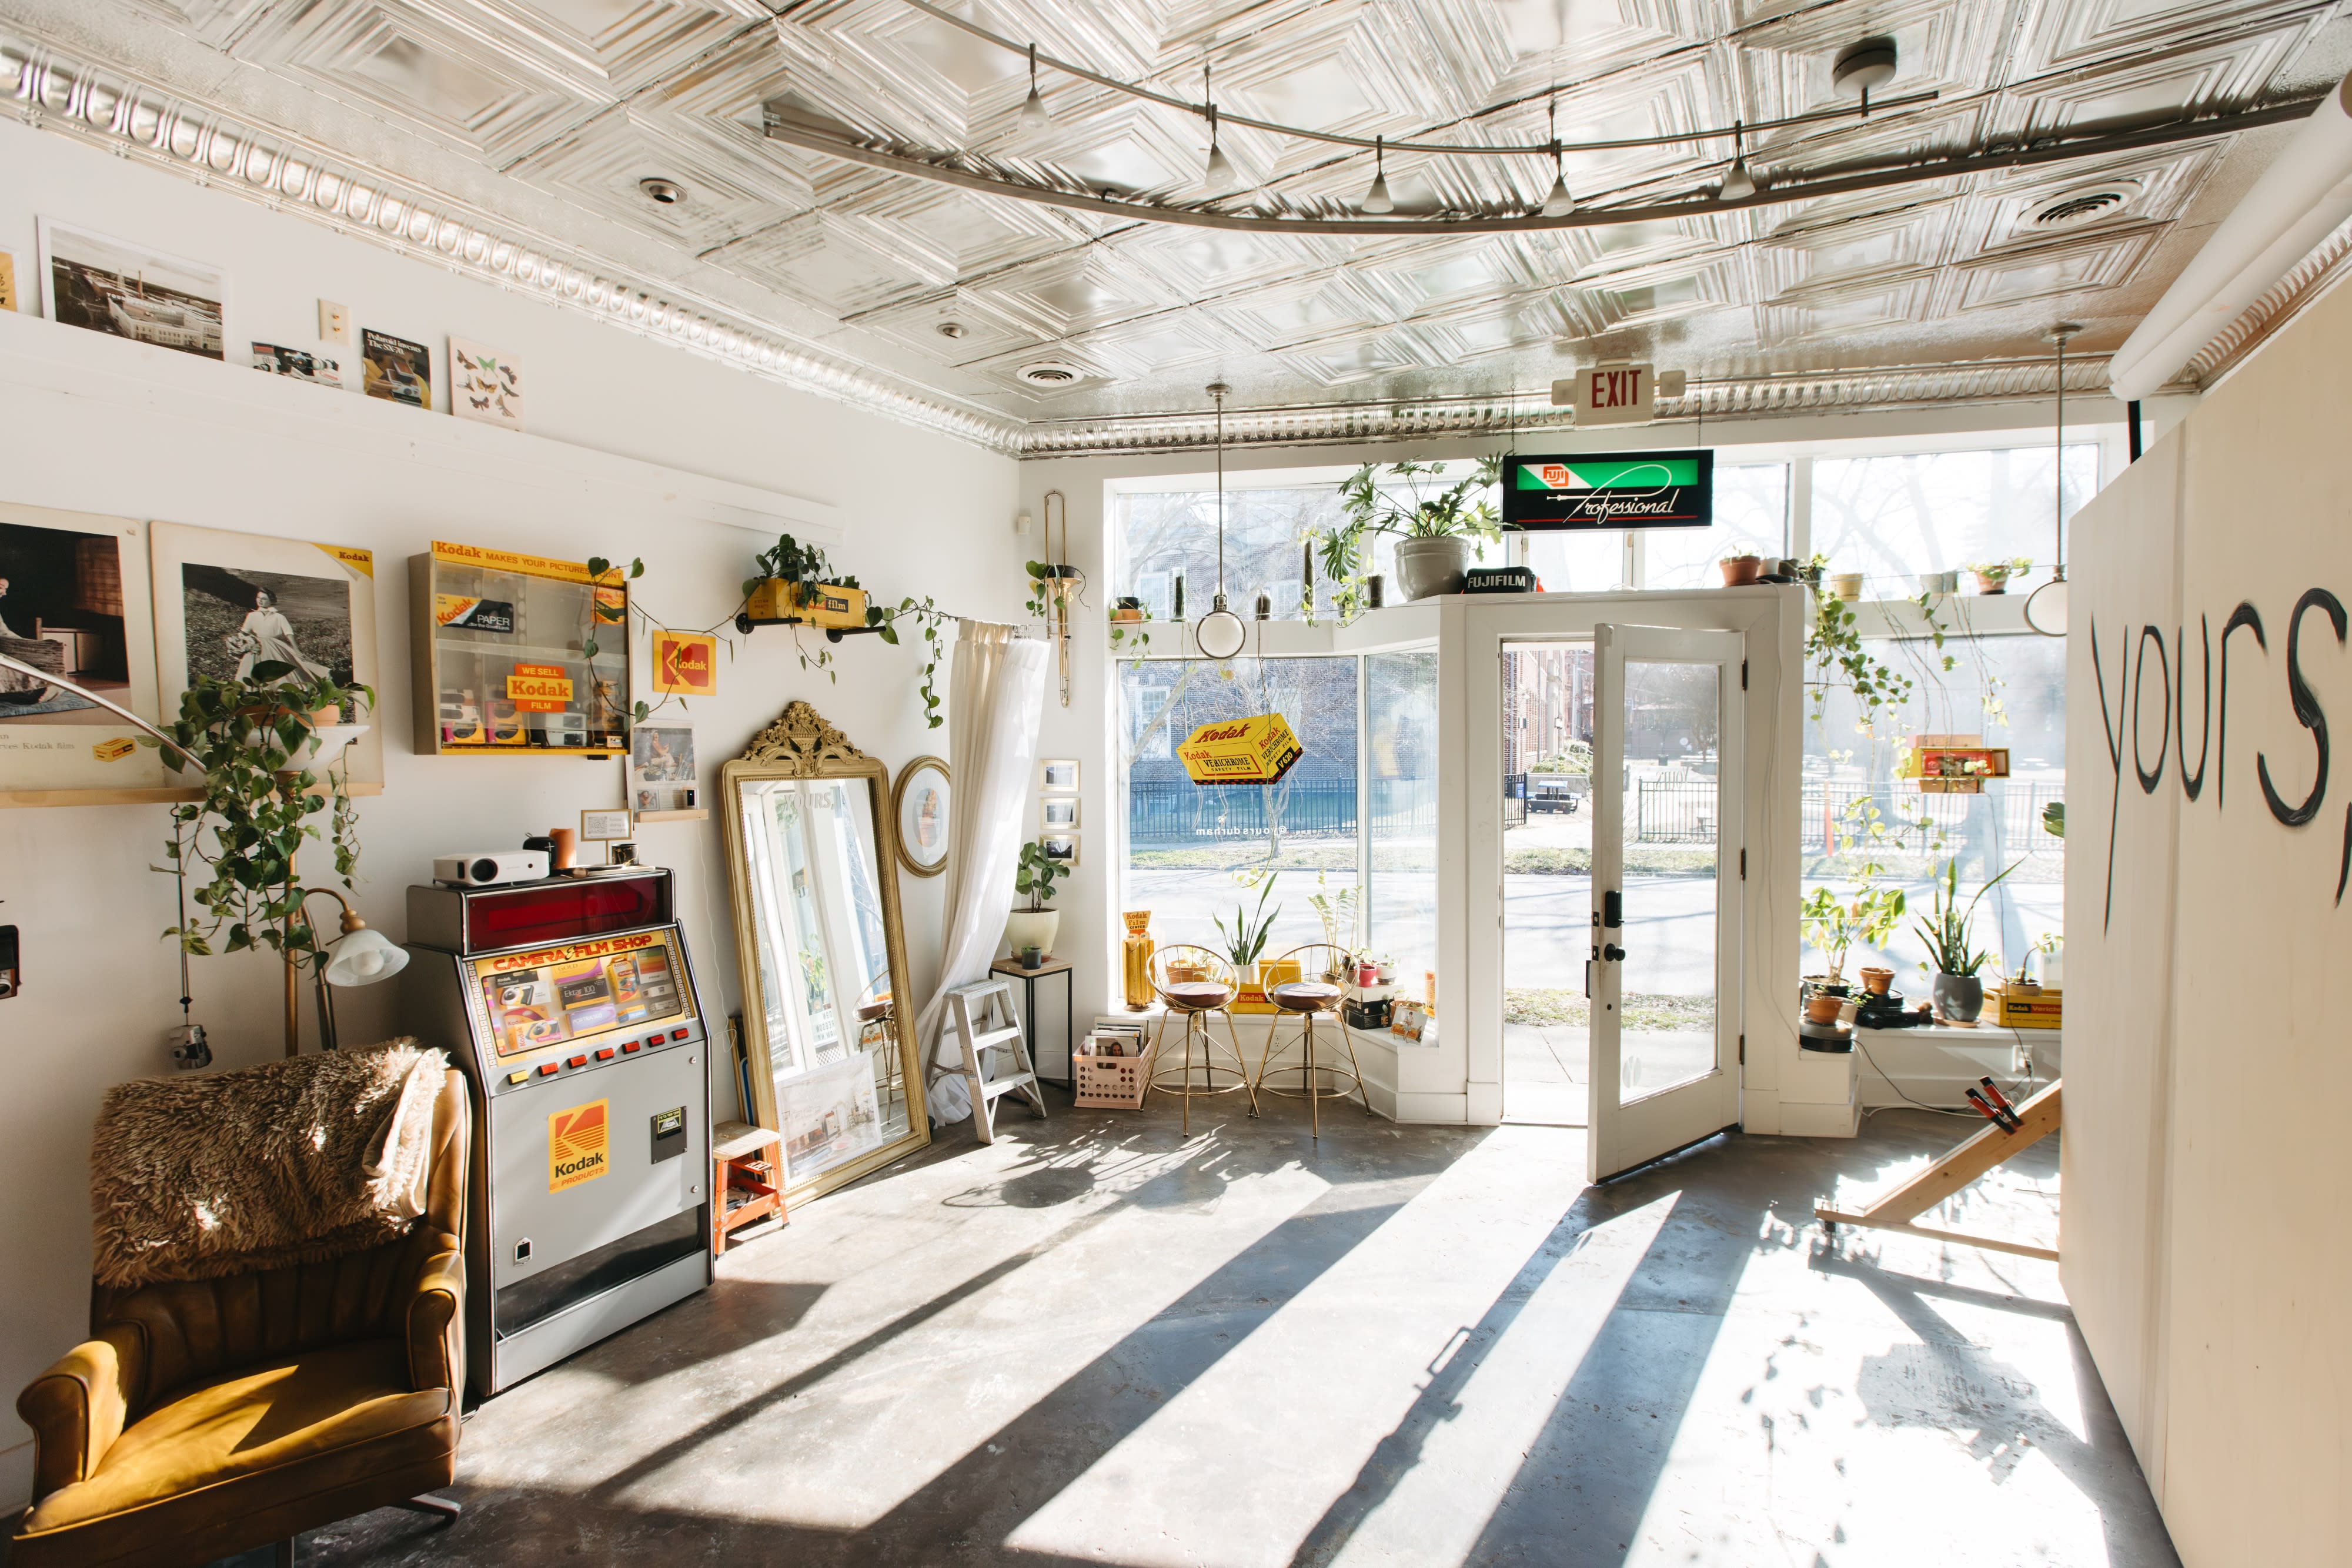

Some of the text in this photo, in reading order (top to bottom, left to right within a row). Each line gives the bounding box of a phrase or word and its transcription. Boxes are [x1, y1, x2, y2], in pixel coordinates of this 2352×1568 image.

[367, 332, 423, 353] Polaroid invents
[368, 339, 382, 349] The
[1591, 369, 1642, 408] EXIT
[1562, 470, 1681, 524] Professional
[339, 551, 369, 562] Kodak
[436, 541, 481, 559] Kodak
[485, 551, 518, 564] MAKES
[522, 558, 546, 569] YOUR
[550, 562, 590, 575] PICTURES
[1468, 575, 1526, 589] FUJIFILM
[436, 598, 474, 623] Kodak
[828, 599, 846, 610] film
[477, 614, 510, 626] PAPER
[522, 667, 559, 676] WE SELL
[511, 680, 570, 697] Kodak
[531, 701, 552, 710] FILM
[1194, 723, 1251, 744] Kodak
[1258, 727, 1281, 750] Kodak
[1261, 728, 1289, 760] VERICHROME
[1266, 737, 1292, 766] SAFETY FILM
[1184, 750, 1212, 761] Kodak
[1203, 757, 1250, 768] VERICHROME
[493, 949, 566, 971] CAMERA
[574, 940, 609, 958] FILM
[613, 935, 653, 951] SHOP
[564, 985, 596, 998] Ektar 100
[517, 1027, 526, 1047] Kodak
[555, 1152, 604, 1179] Kodak
[561, 1166, 604, 1186] PRODUCTS
